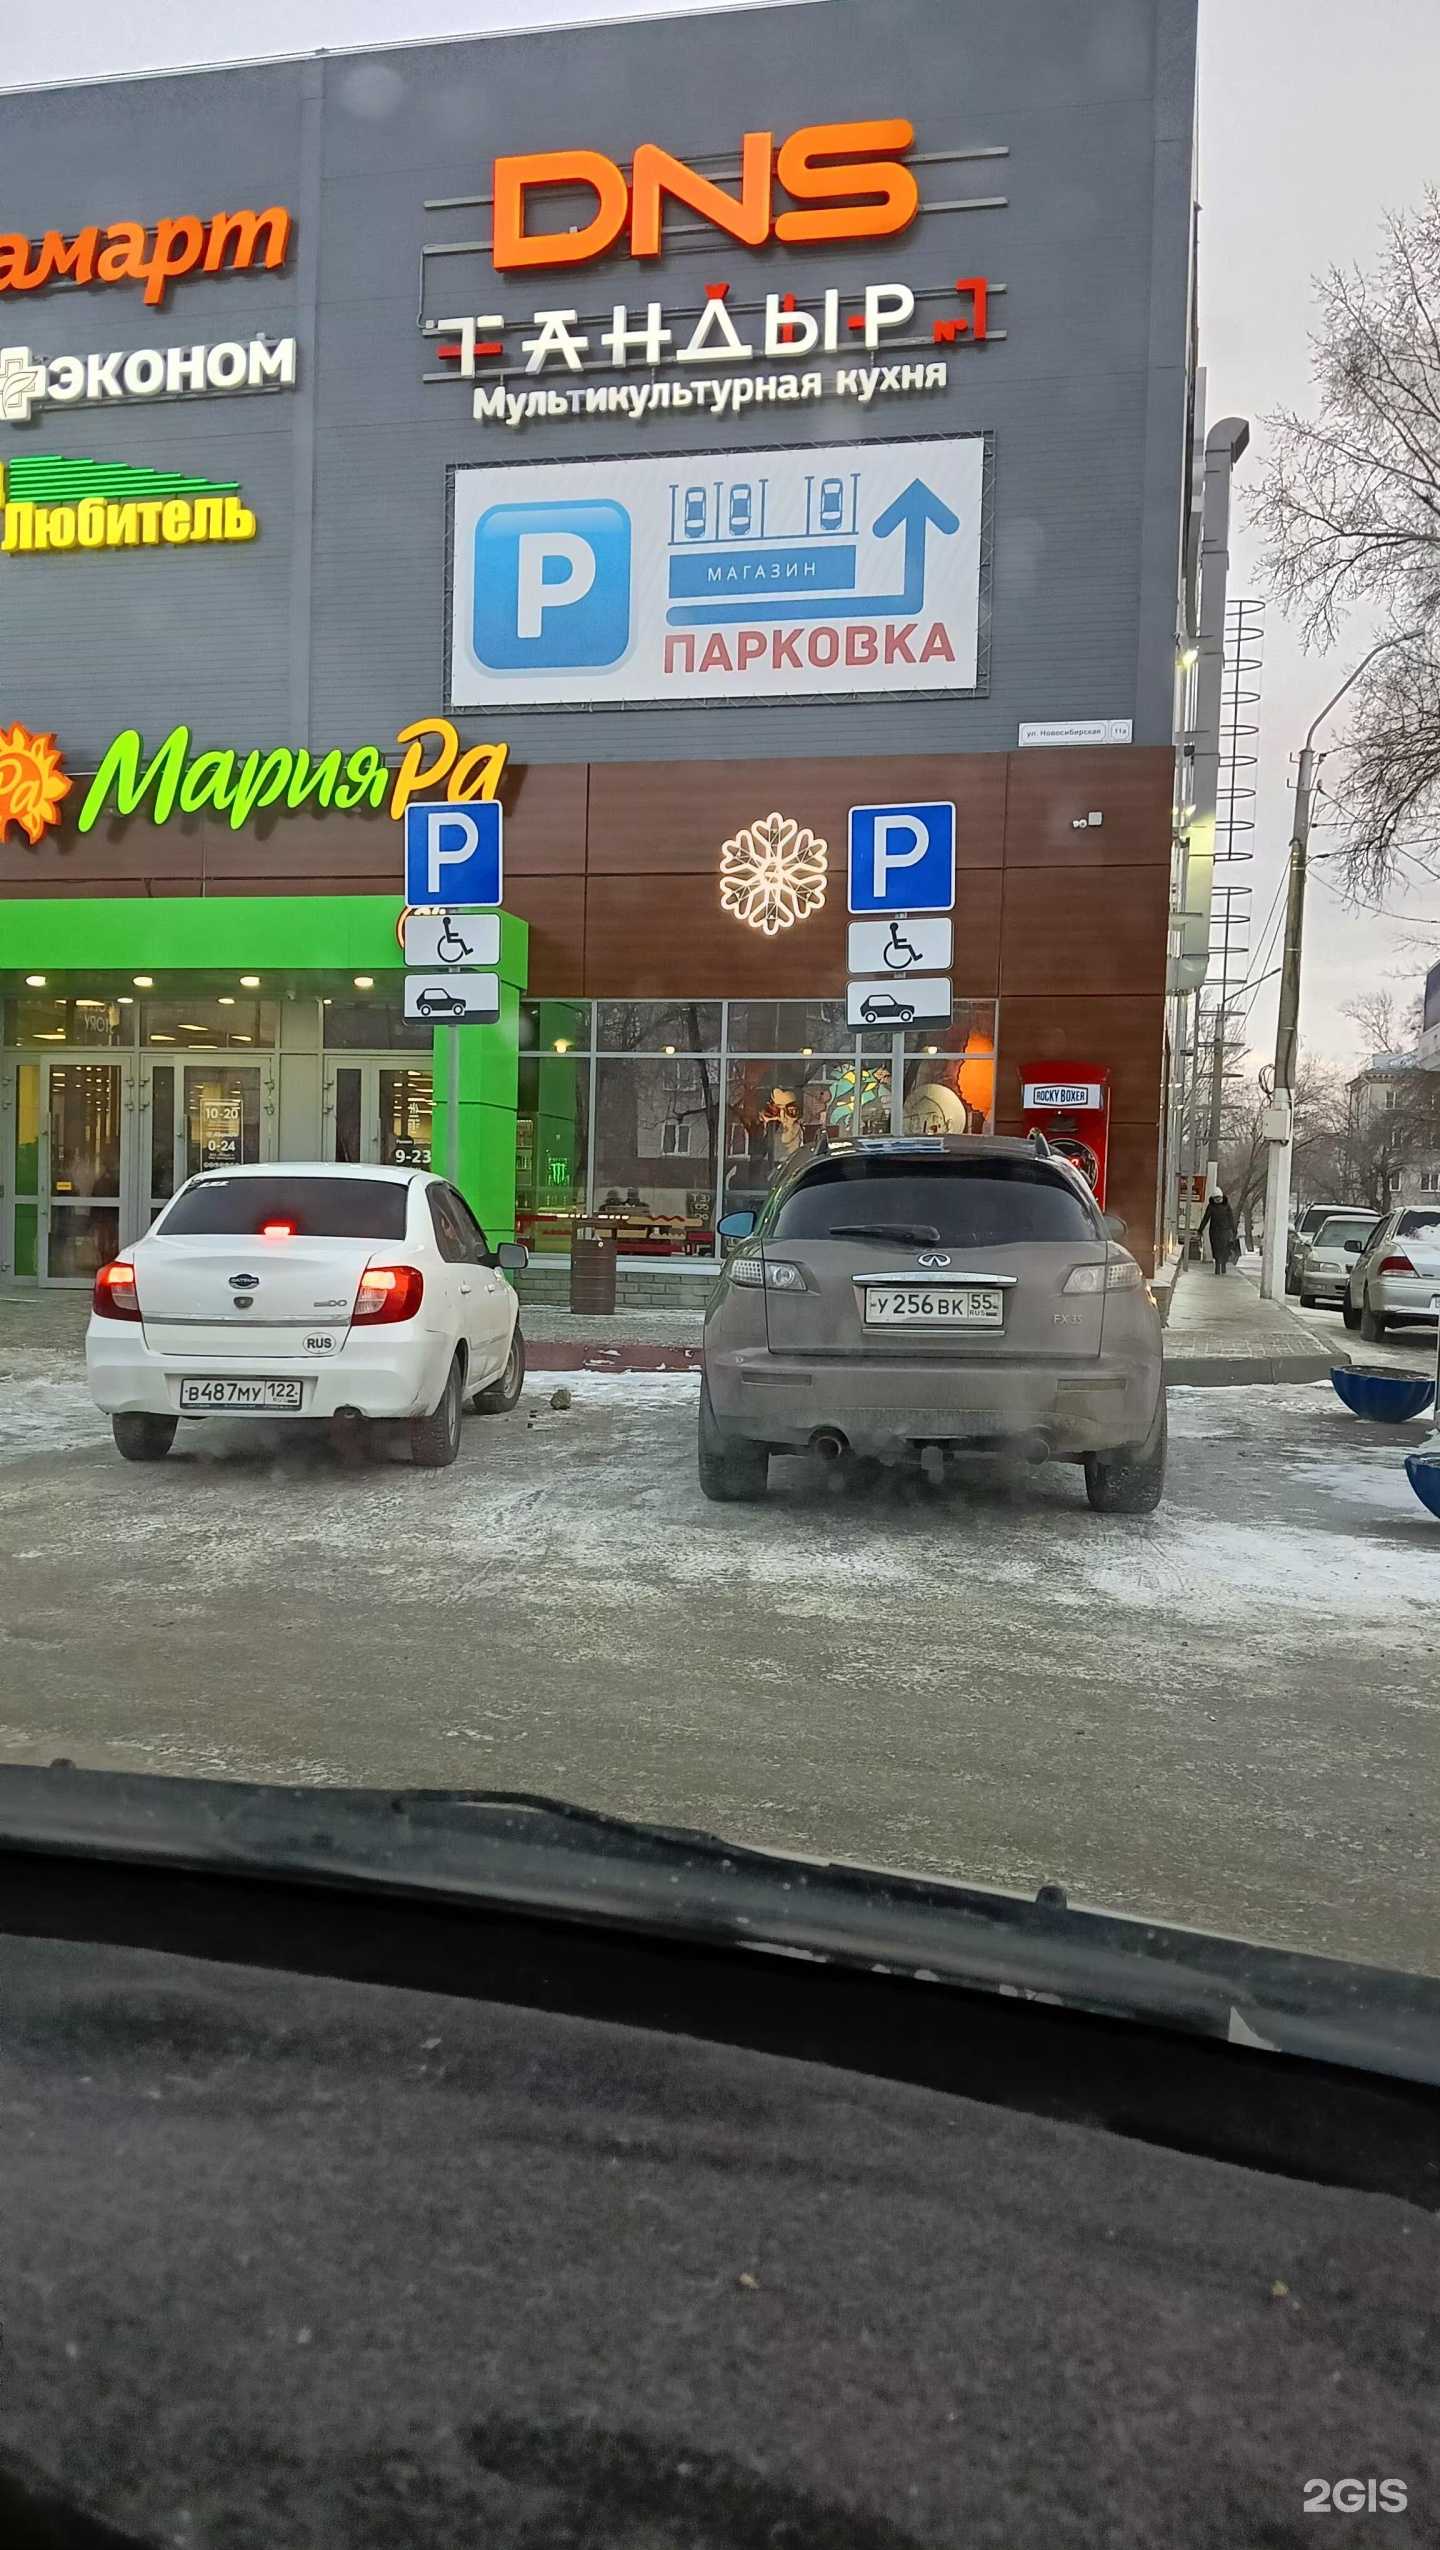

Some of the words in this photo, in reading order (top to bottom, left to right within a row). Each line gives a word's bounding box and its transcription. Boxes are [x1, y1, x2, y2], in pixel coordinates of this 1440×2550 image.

[493, 118, 918, 271] DNS
[437, 283, 914, 376] ТАНДЫР
[472, 371, 822, 425] Мультикультурная
[836, 361, 947, 402] кухня
[1, 497, 256, 551] Любитель
[517, 532, 596, 639] P
[707, 562, 816, 582] МАГАЗИН
[664, 622, 956, 674] ПАРКОВКА
[427, 811, 478, 893] P
[873, 814, 929, 897] P
[205, 1107, 239, 1119] 10-20
[1037, 1090, 1060, 1102] ROCKY
[1061, 1089, 1085, 1103] BOXER
[208, 1140, 236, 1151] 0-24
[395, 1149, 432, 1164] 9-23
[971, 1294, 993, 1309] 55
[306, 1337, 332, 1349] RUS
[267, 1383, 296, 1397] 122
